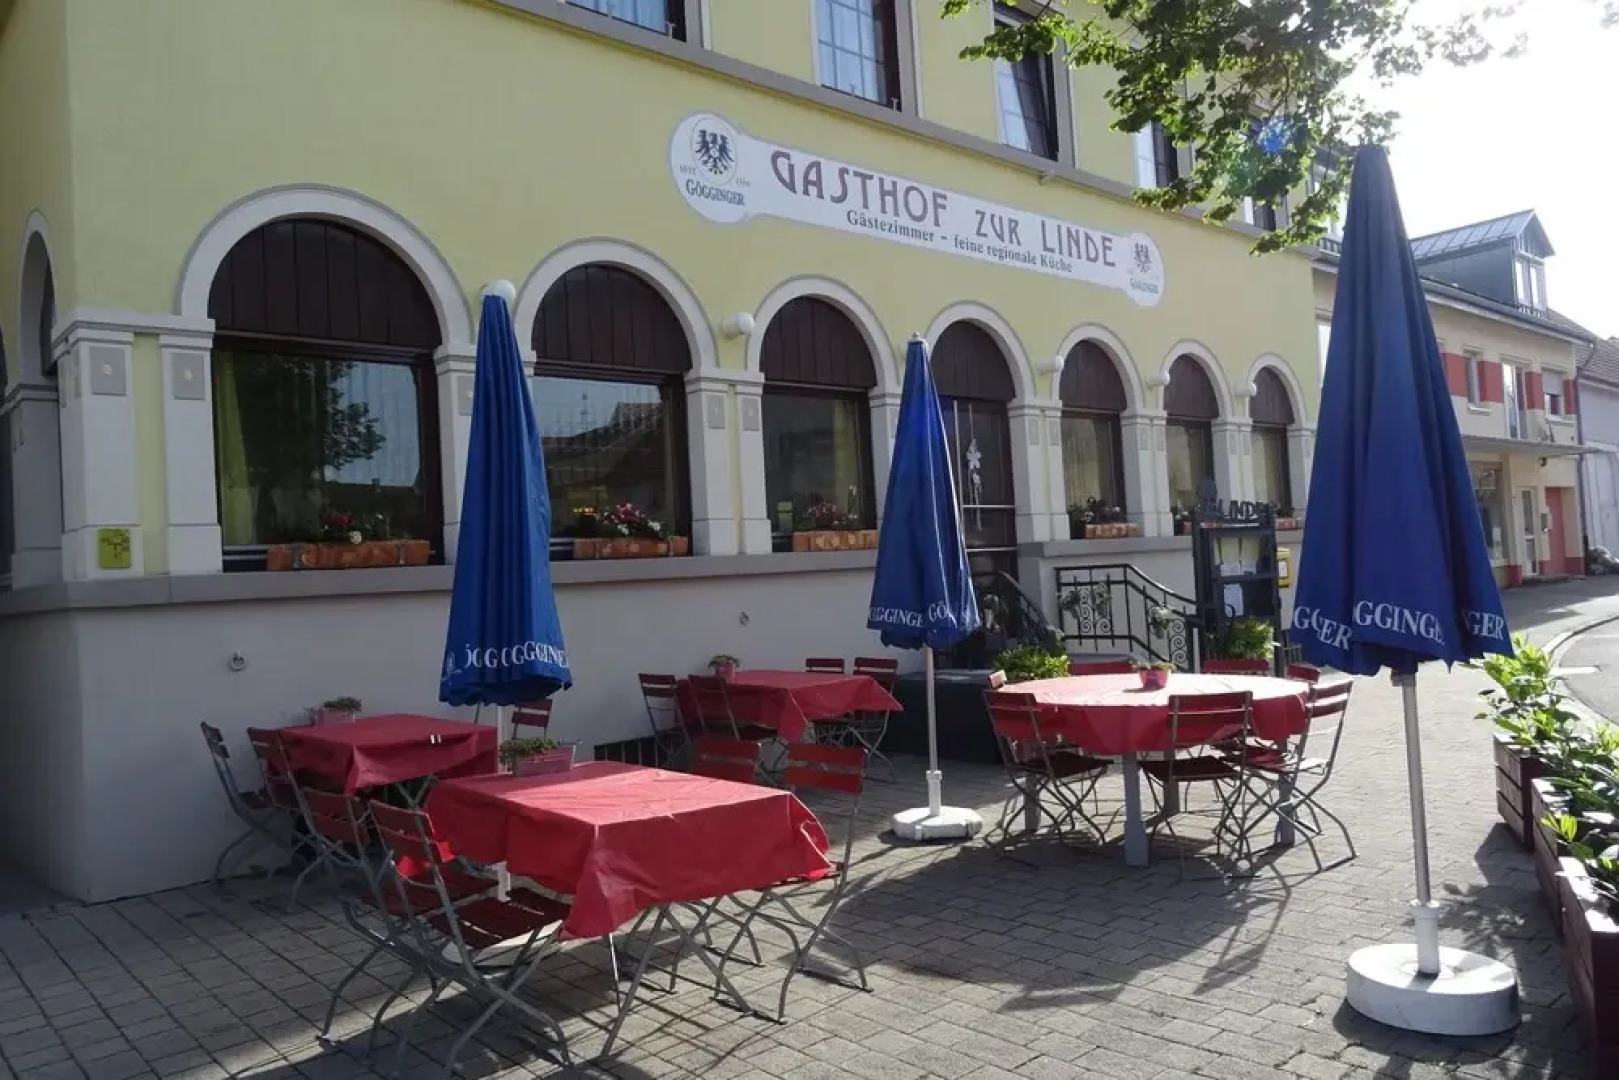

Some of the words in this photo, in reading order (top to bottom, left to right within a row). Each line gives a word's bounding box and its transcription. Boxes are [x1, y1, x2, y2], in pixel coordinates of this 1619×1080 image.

[771, 150, 948, 228] GASTHOF
[975, 208, 1022, 247] ZUR
[1041, 219, 1116, 268] LINDE
[846, 208, 935, 243] Gästezimmer
[954, 233, 984, 255] feine
[987, 243, 1037, 266] regionale
[1040, 252, 1073, 274] Küche
